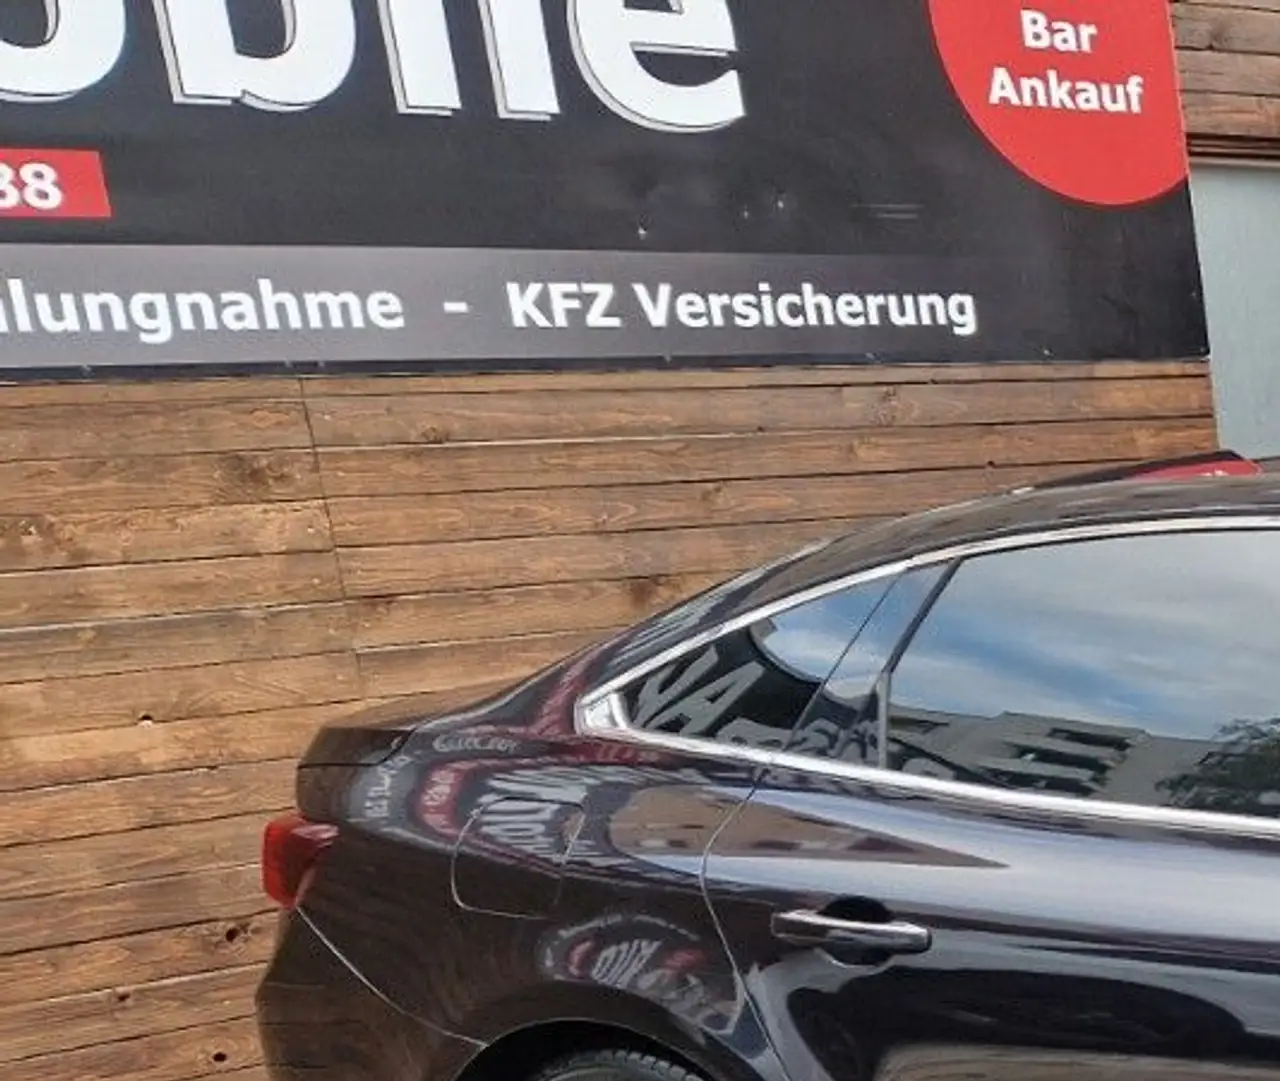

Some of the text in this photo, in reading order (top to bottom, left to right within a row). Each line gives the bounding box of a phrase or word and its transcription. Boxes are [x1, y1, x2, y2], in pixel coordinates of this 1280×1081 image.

[1020, 8, 1098, 53] Bar
[988, 66, 1144, 114] Ankauf
[0, 278, 406, 344] lungnahme
[506, 281, 622, 328] KFZ
[632, 281, 977, 336] Versicherung
